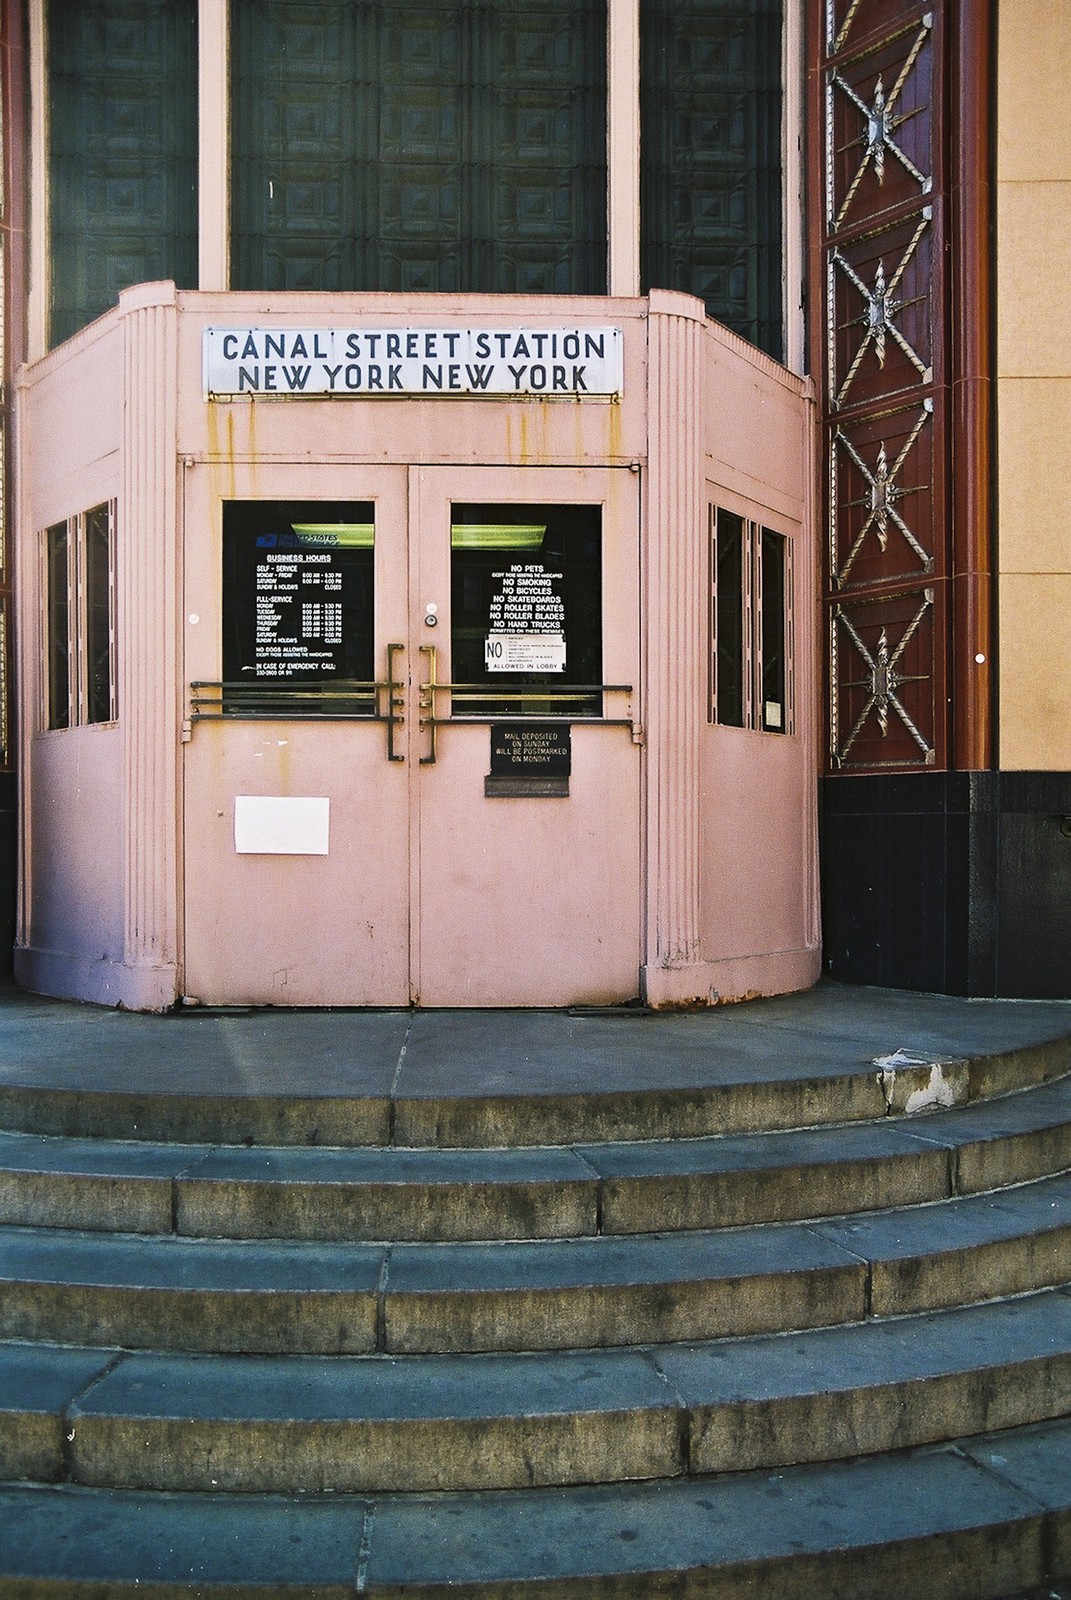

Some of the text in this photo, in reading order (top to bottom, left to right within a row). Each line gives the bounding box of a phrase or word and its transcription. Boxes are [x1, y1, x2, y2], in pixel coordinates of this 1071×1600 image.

[222, 333, 605, 359] CANAL STREET STATION
[238, 365, 588, 391] NEW YORK NEW YORK
[487, 642, 502, 658] NO
